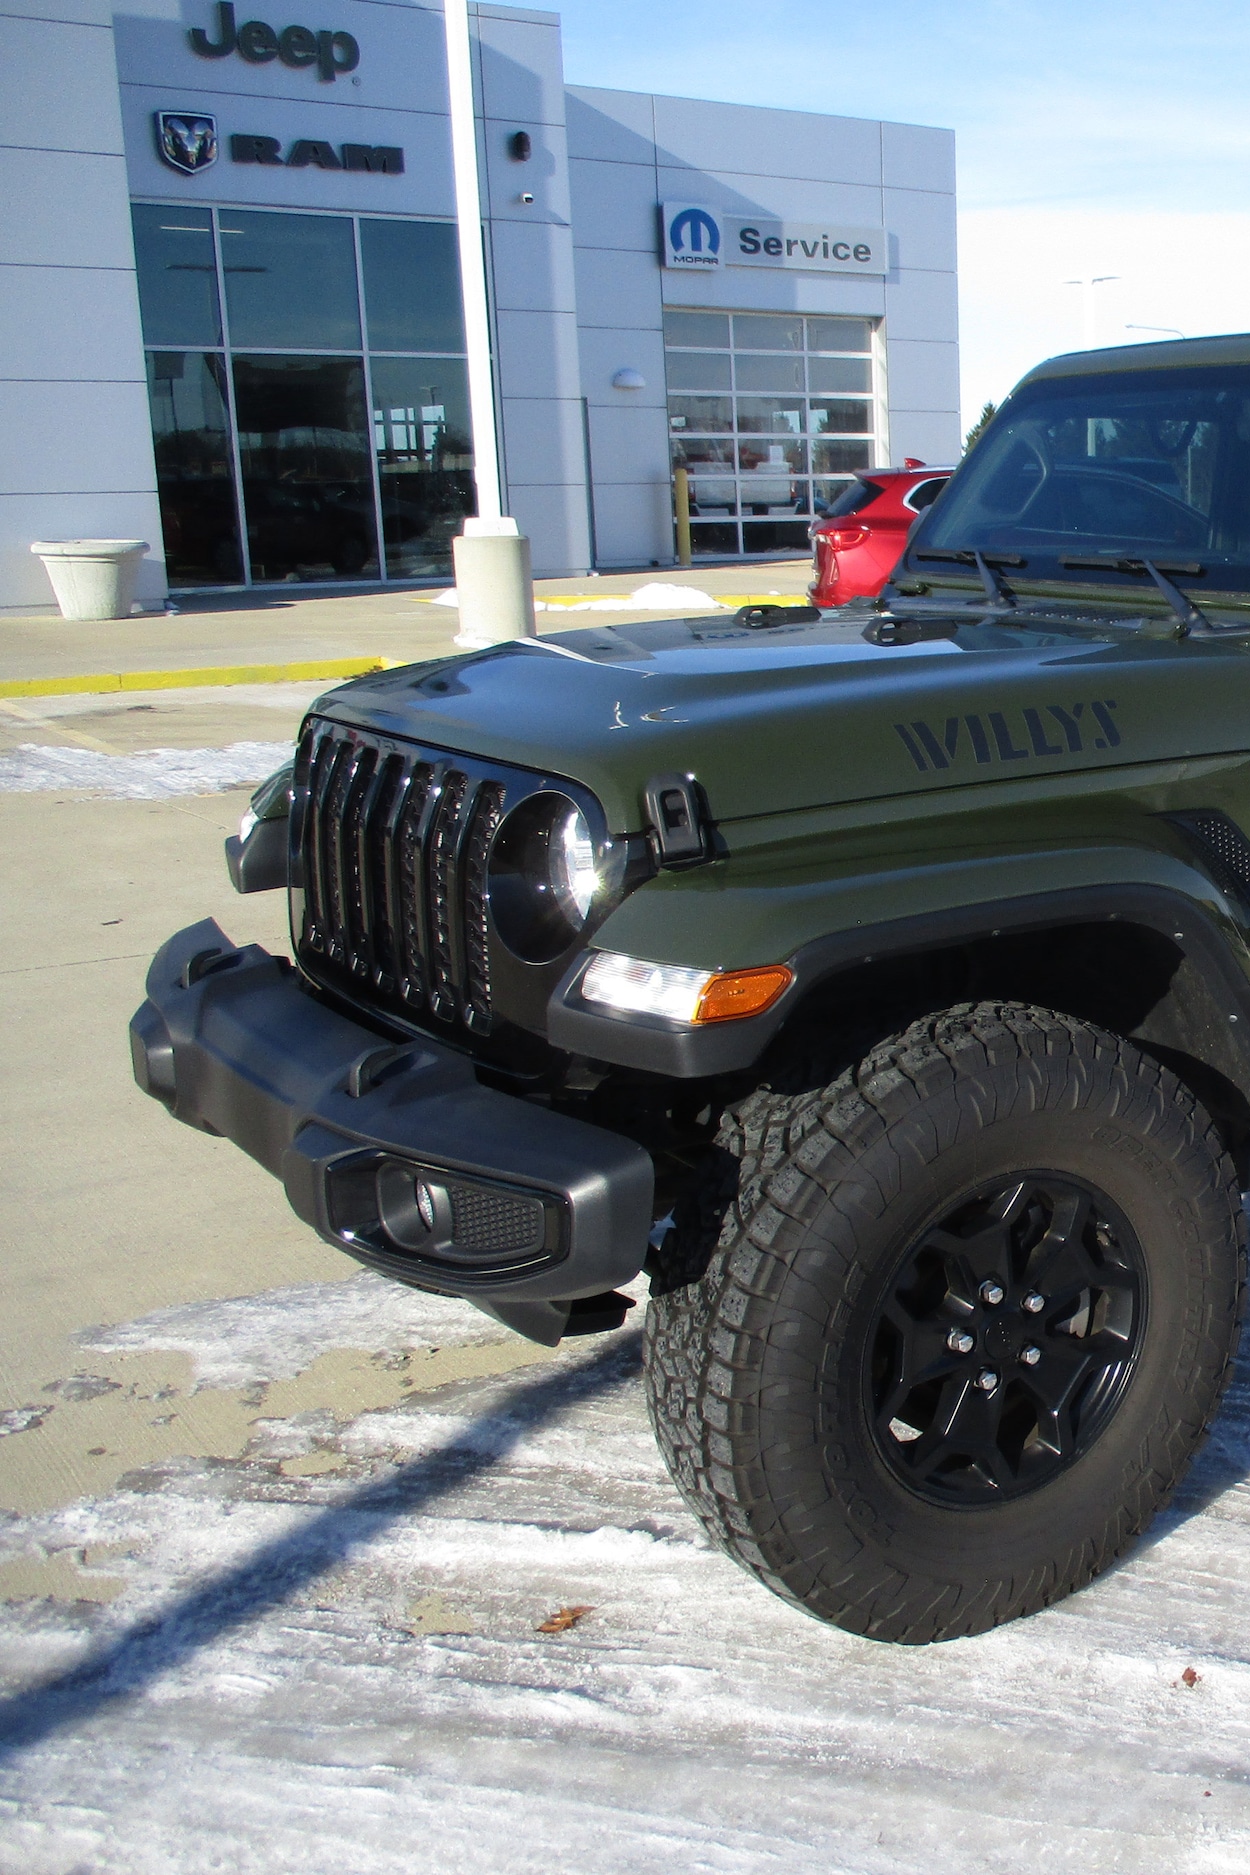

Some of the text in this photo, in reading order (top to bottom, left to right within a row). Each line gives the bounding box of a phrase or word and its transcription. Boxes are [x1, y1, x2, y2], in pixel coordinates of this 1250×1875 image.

[189, 1, 360, 82] Jeep
[231, 134, 405, 174] RAM
[673, 255, 719, 265] MOPAR
[739, 227, 872, 262] Service
[893, 700, 1121, 771] WILLYS
